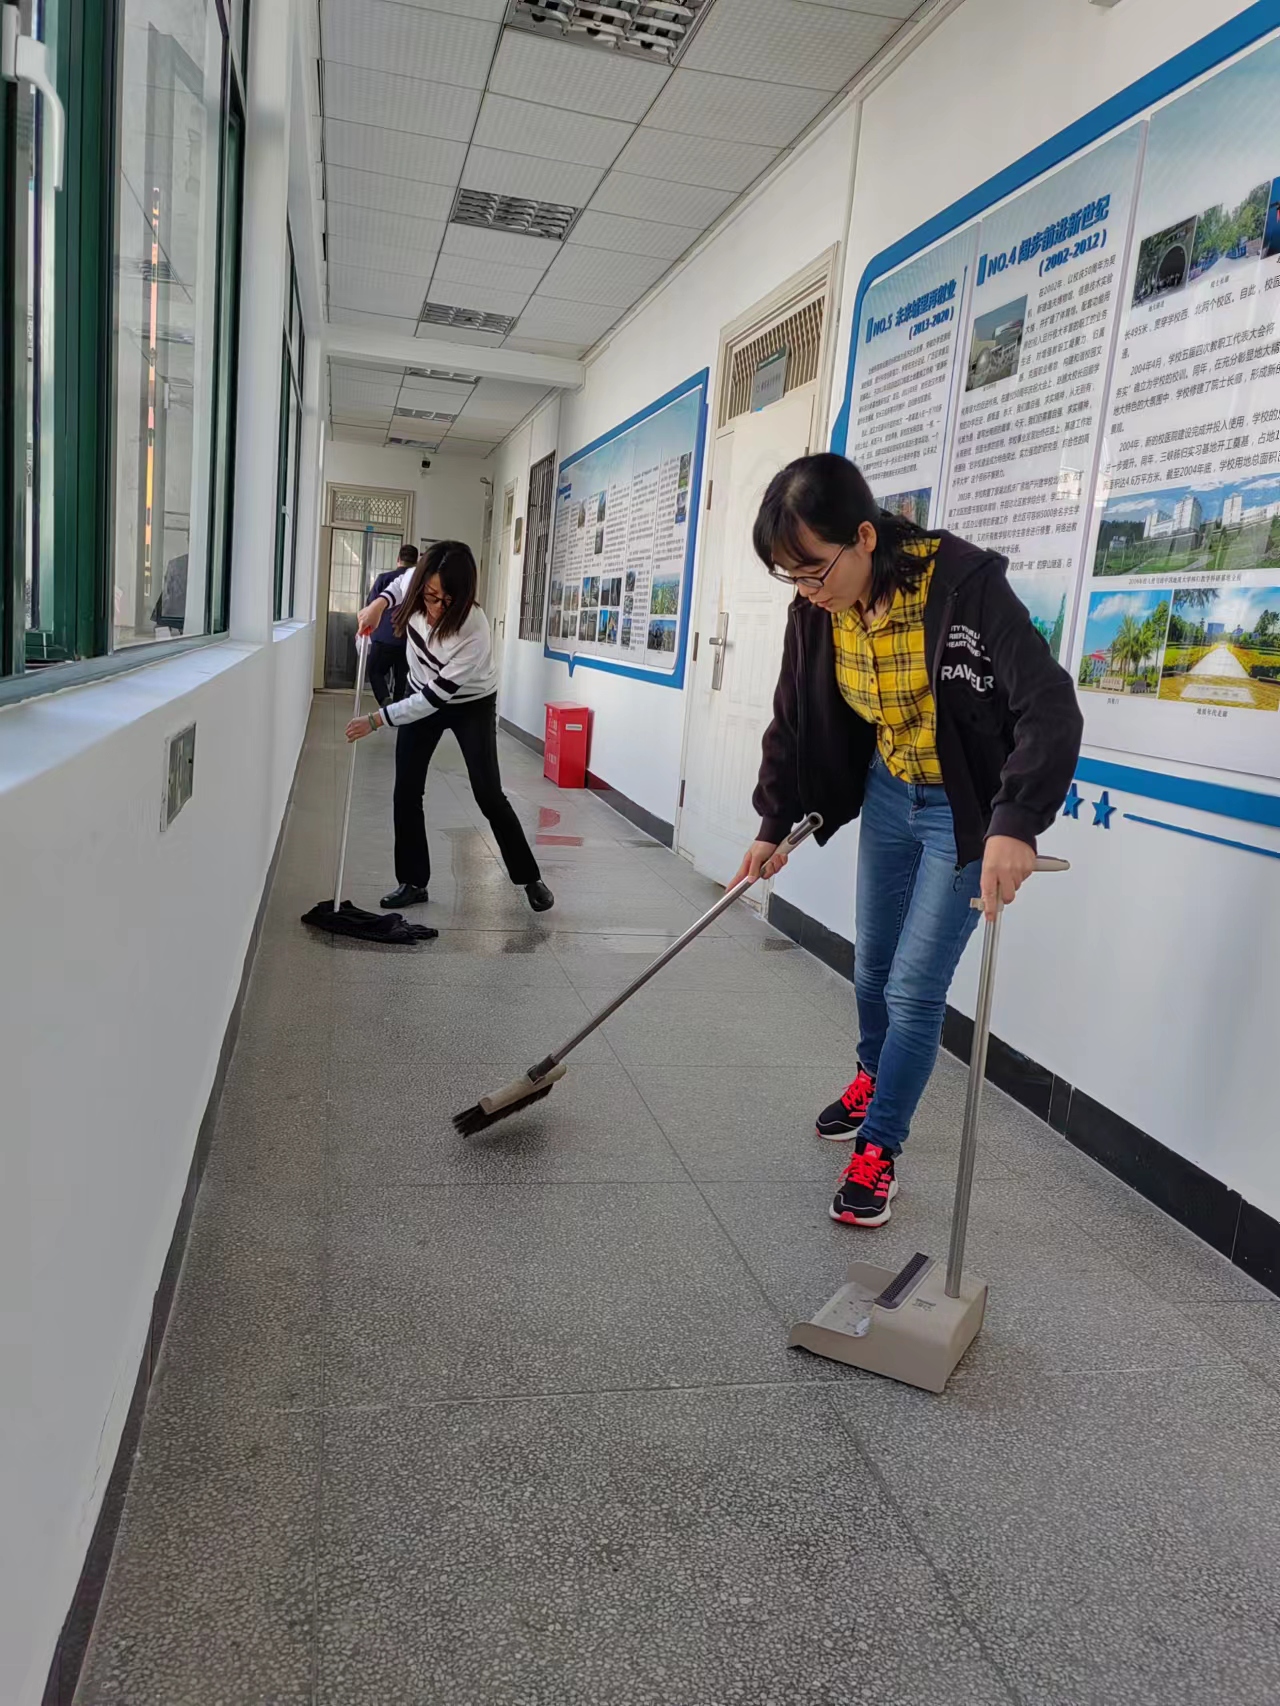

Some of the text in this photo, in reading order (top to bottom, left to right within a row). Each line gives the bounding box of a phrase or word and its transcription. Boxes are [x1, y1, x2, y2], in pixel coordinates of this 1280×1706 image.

[987, 194, 1111, 278] NO.4 阔步前进新世纪
[1038, 229, 1107, 277] (2002-2012)
[872, 313, 893, 337] NO.5
